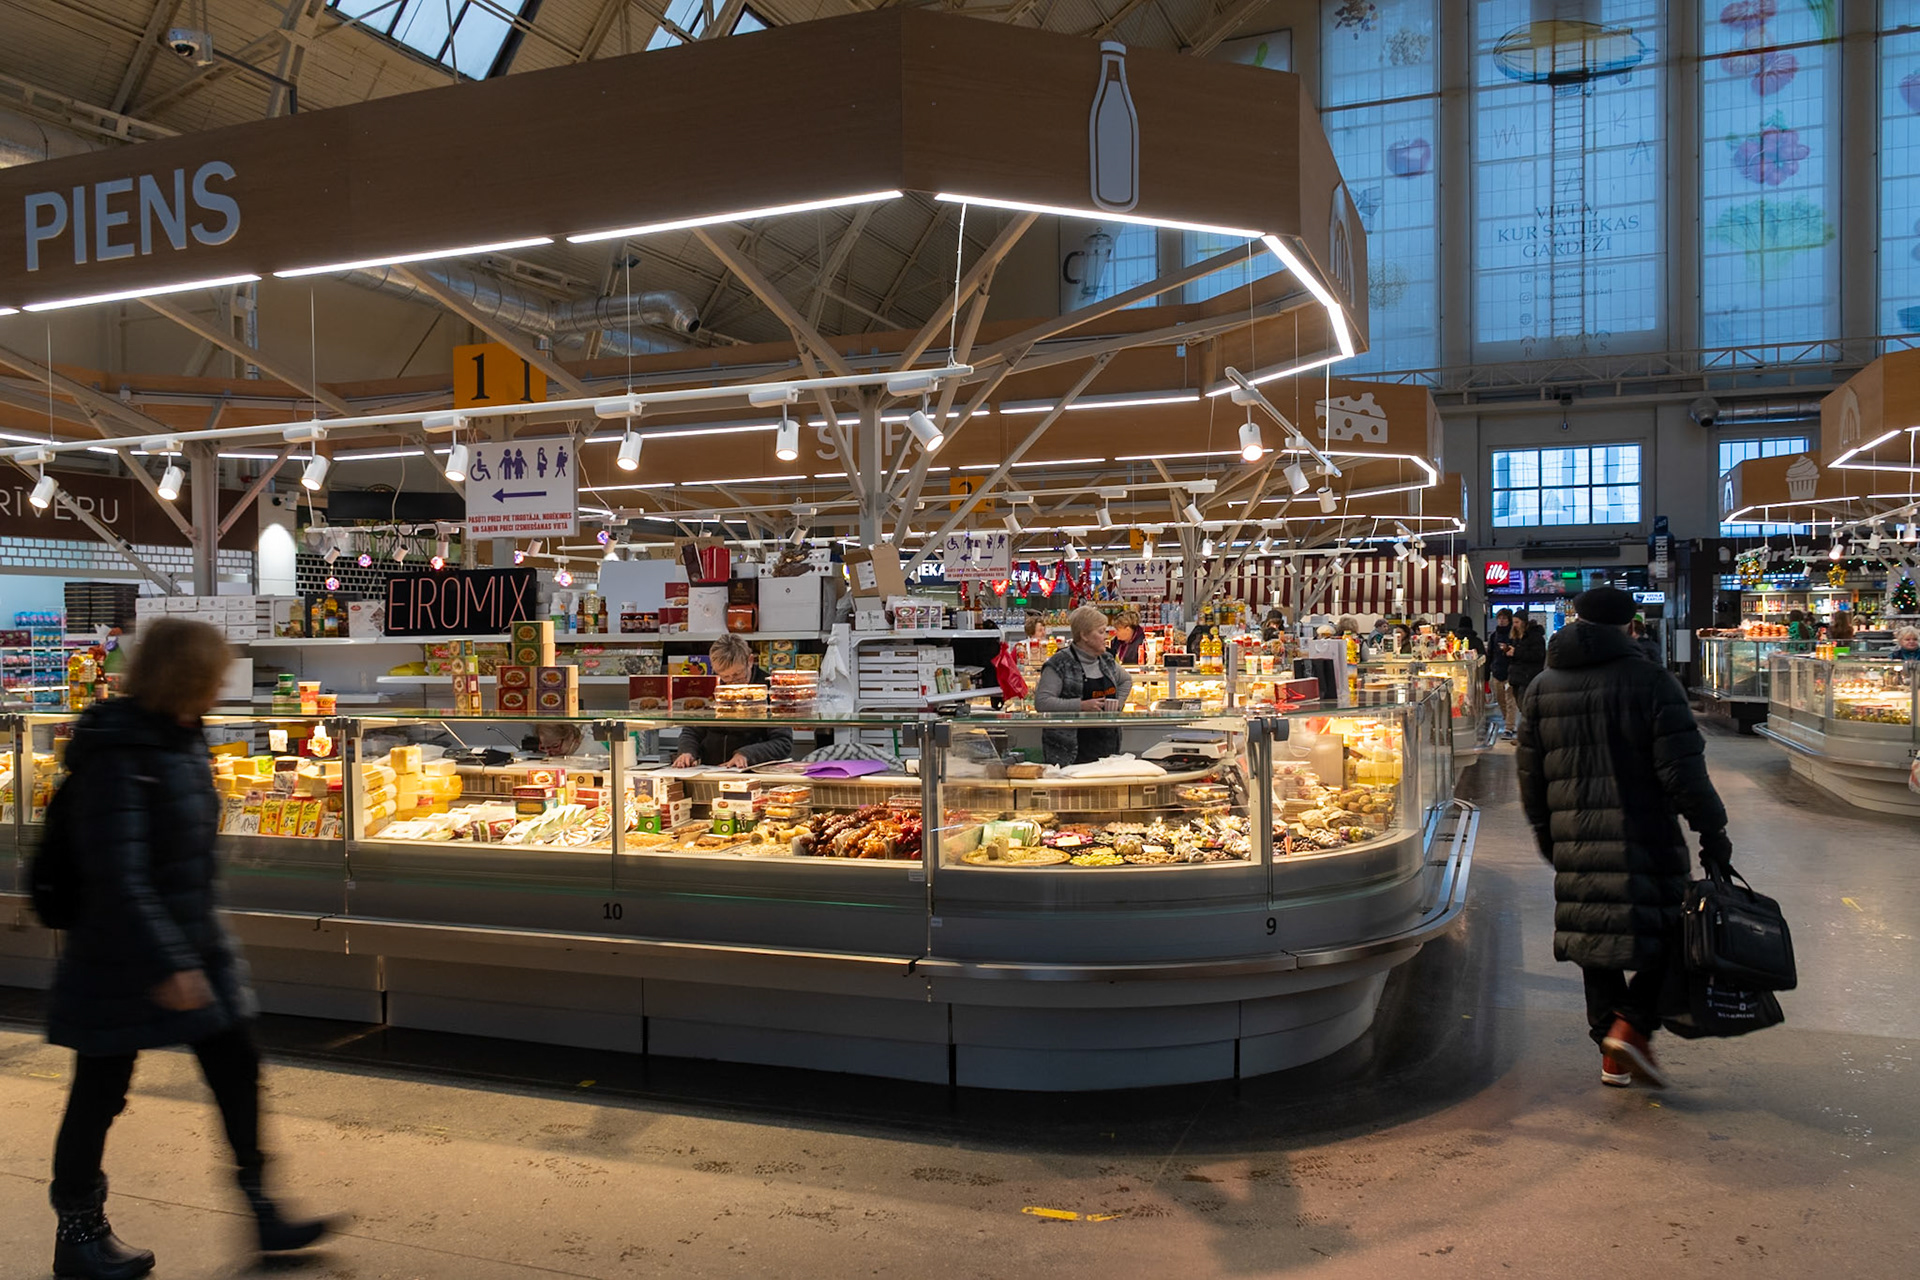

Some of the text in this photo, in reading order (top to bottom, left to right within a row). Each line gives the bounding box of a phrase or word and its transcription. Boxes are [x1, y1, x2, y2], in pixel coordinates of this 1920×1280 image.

[25, 160, 241, 272] PIENS
[1498, 226, 1538, 242] KUR
[471, 353, 490, 401] 1
[1485, 564, 1508, 583] illy
[389, 574, 530, 630] EIROMIX
[603, 902, 623, 920] 10
[1266, 917, 1277, 936] 9
